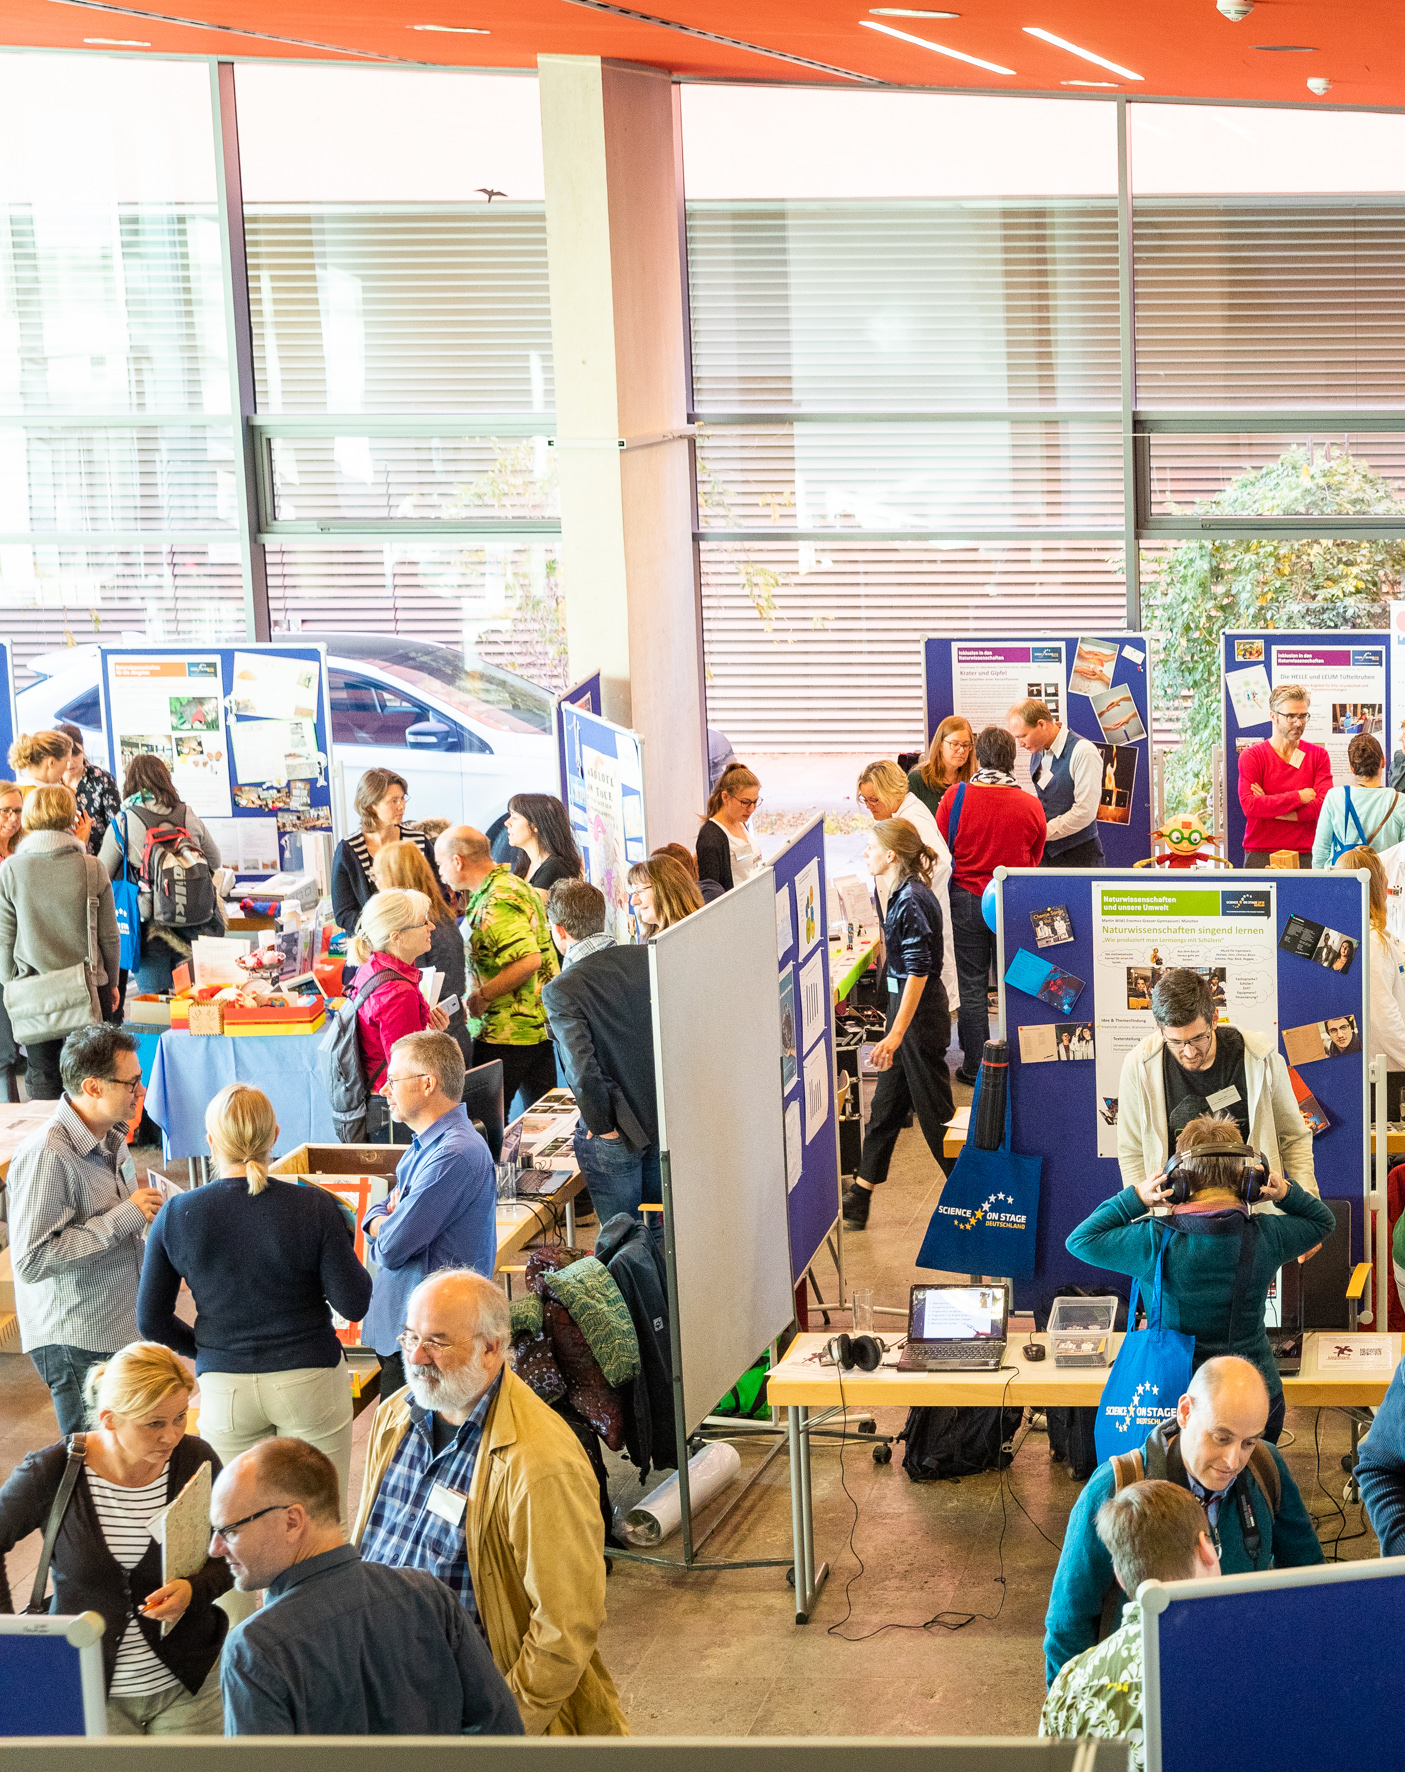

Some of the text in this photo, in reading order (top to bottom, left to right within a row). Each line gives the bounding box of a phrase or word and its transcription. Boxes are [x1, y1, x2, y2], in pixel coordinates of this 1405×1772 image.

[1103, 926, 1263, 936] Naturwissenschaften singend lernen
[938, 1205, 1026, 1223] SCIENCE ON STAGE
[986, 1220, 1025, 1229] DEUTSCHLAND
[1106, 1406, 1177, 1417] SCIENCE ON STAGE
